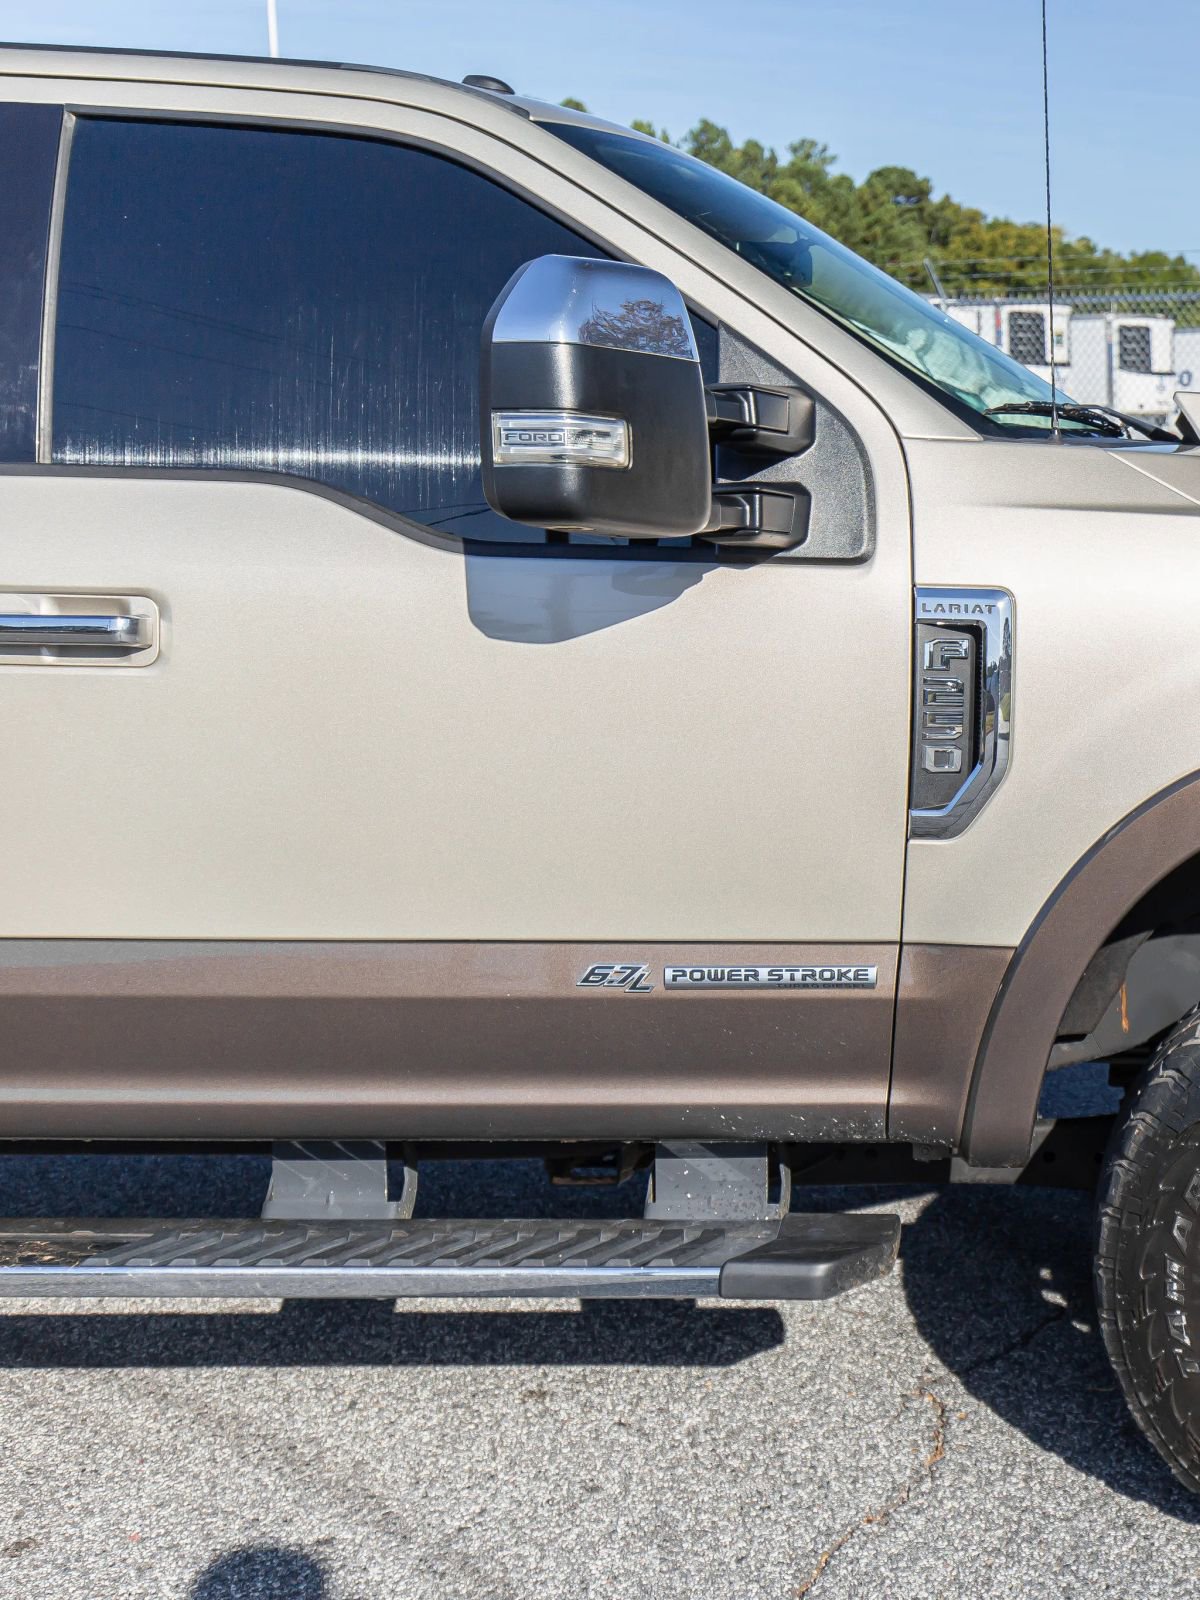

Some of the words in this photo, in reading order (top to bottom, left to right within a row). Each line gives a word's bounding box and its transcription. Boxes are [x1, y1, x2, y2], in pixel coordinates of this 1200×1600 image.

[504, 432, 563, 442] FORD
[920, 602, 996, 615] LARIAT
[671, 968, 760, 982] POWER
[767, 968, 869, 982] STROKE
